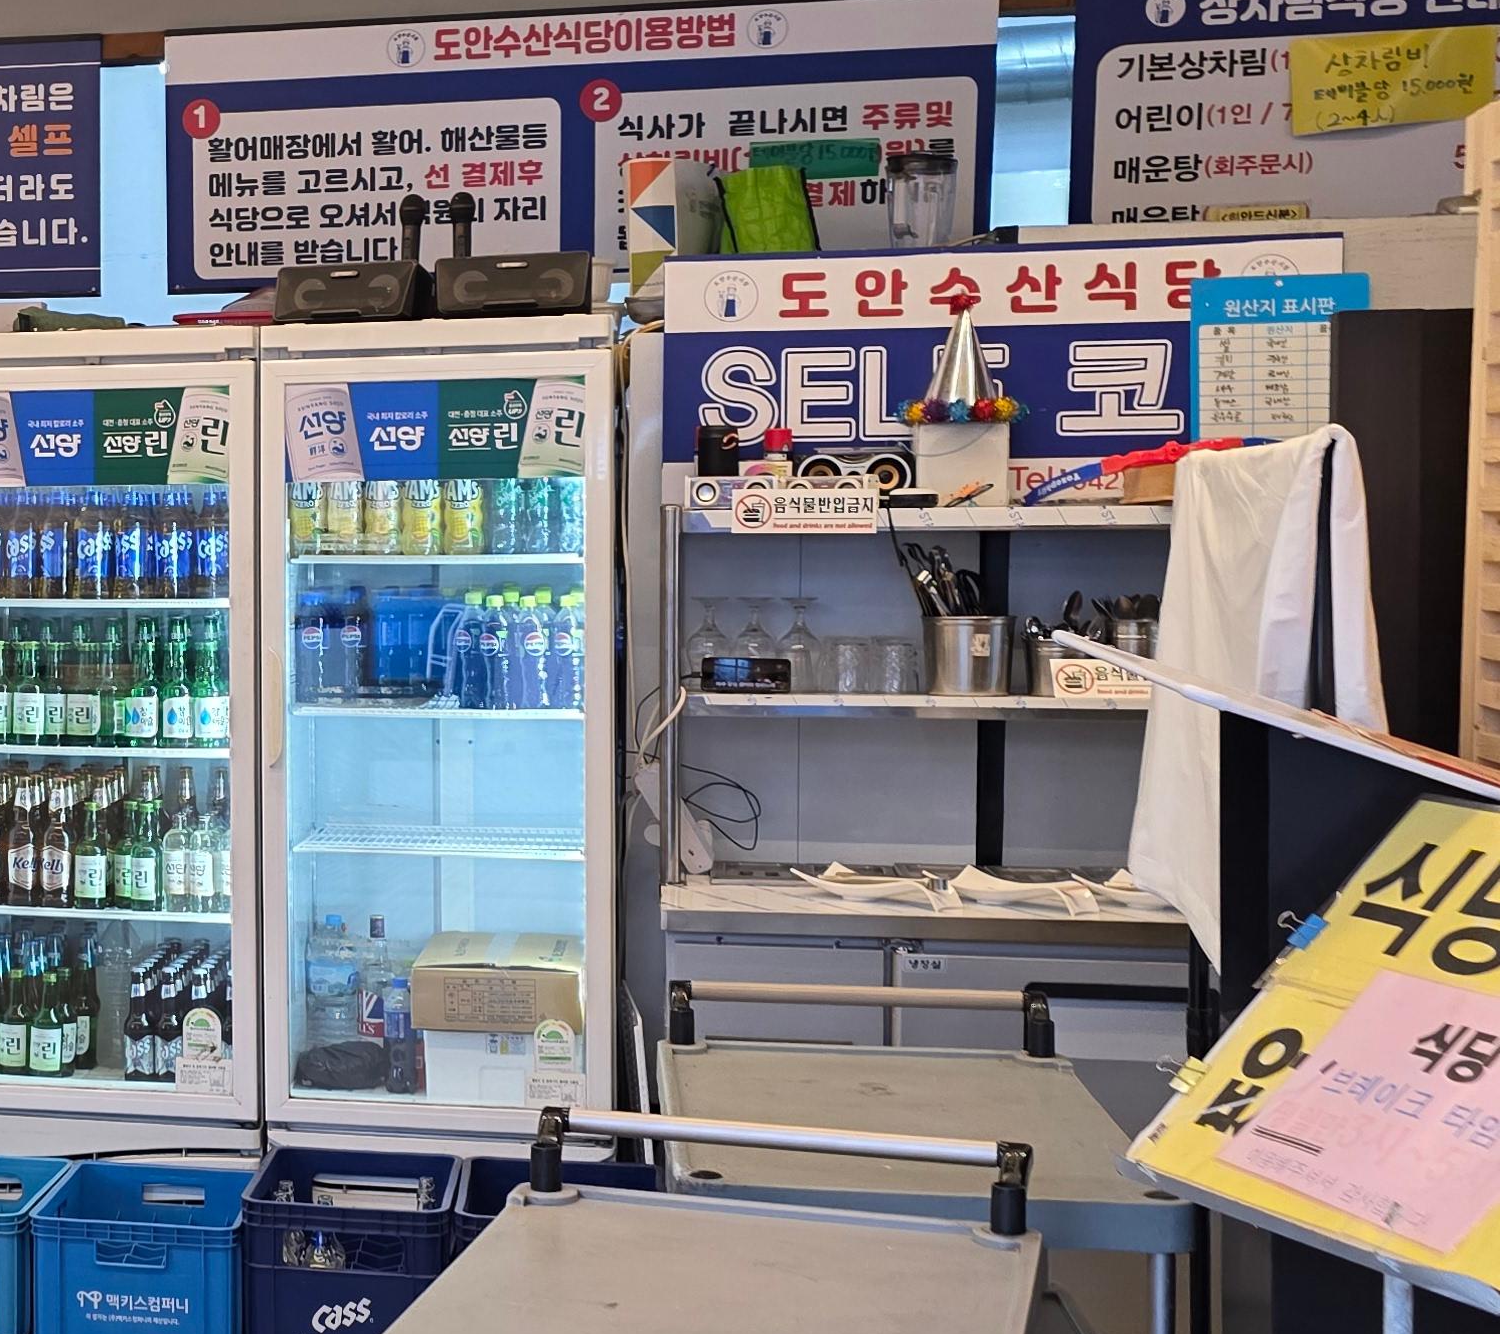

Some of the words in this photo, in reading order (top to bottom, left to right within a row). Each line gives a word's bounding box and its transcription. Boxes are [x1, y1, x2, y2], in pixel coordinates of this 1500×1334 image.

[433, 13, 735, 62] 도안수산식당이용방법
[1324, 45, 1429, 77] 상차림비
[593, 87, 610, 111] 2
[193, 105, 206, 129] 1
[617, 111, 706, 140] 식사가
[728, 105, 848, 137] 끝나시면
[862, 100, 953, 131] 주류및
[1115, 101, 1252, 133] 어린이(1인
[8, 123, 73, 157] 셀프
[208, 132, 362, 163] 활어매장에서
[371, 129, 431, 156] 활어.
[441, 123, 548, 152] 해산물등
[208, 170, 287, 197] 메뉴를
[297, 166, 414, 194] 고르시고,
[424, 163, 450, 190] 선
[461, 159, 544, 188] 결제후
[1113, 150, 1314, 185] 매운탕(회주문시)
[209, 205, 310, 233] 식당으로
[319, 201, 396, 228] 오셔서
[493, 195, 547, 222] 자리
[209, 240, 285, 268] 안내를
[294, 237, 397, 264] 받습니다
[1223, 298, 1276, 318] 원산지
[1281, 297, 1336, 315] 표시판
[1056, 338, 1184, 437] 코
[201, 417, 228, 455] 린
[299, 410, 346, 440] 선양
[369, 427, 425, 451] 선양
[449, 428, 490, 447] 선양
[493, 423, 518, 449] 린
[555, 407, 585, 448] 린
[30, 434, 81, 457] 선양
[103, 436, 142, 454] 선양
[145, 431, 168, 457] 린
[774, 497, 873, 513] 음식물반입금지
[1322, 1069, 1434, 1119] 브레이크
[106, 1294, 189, 1314] 맥키스컴퍼니
